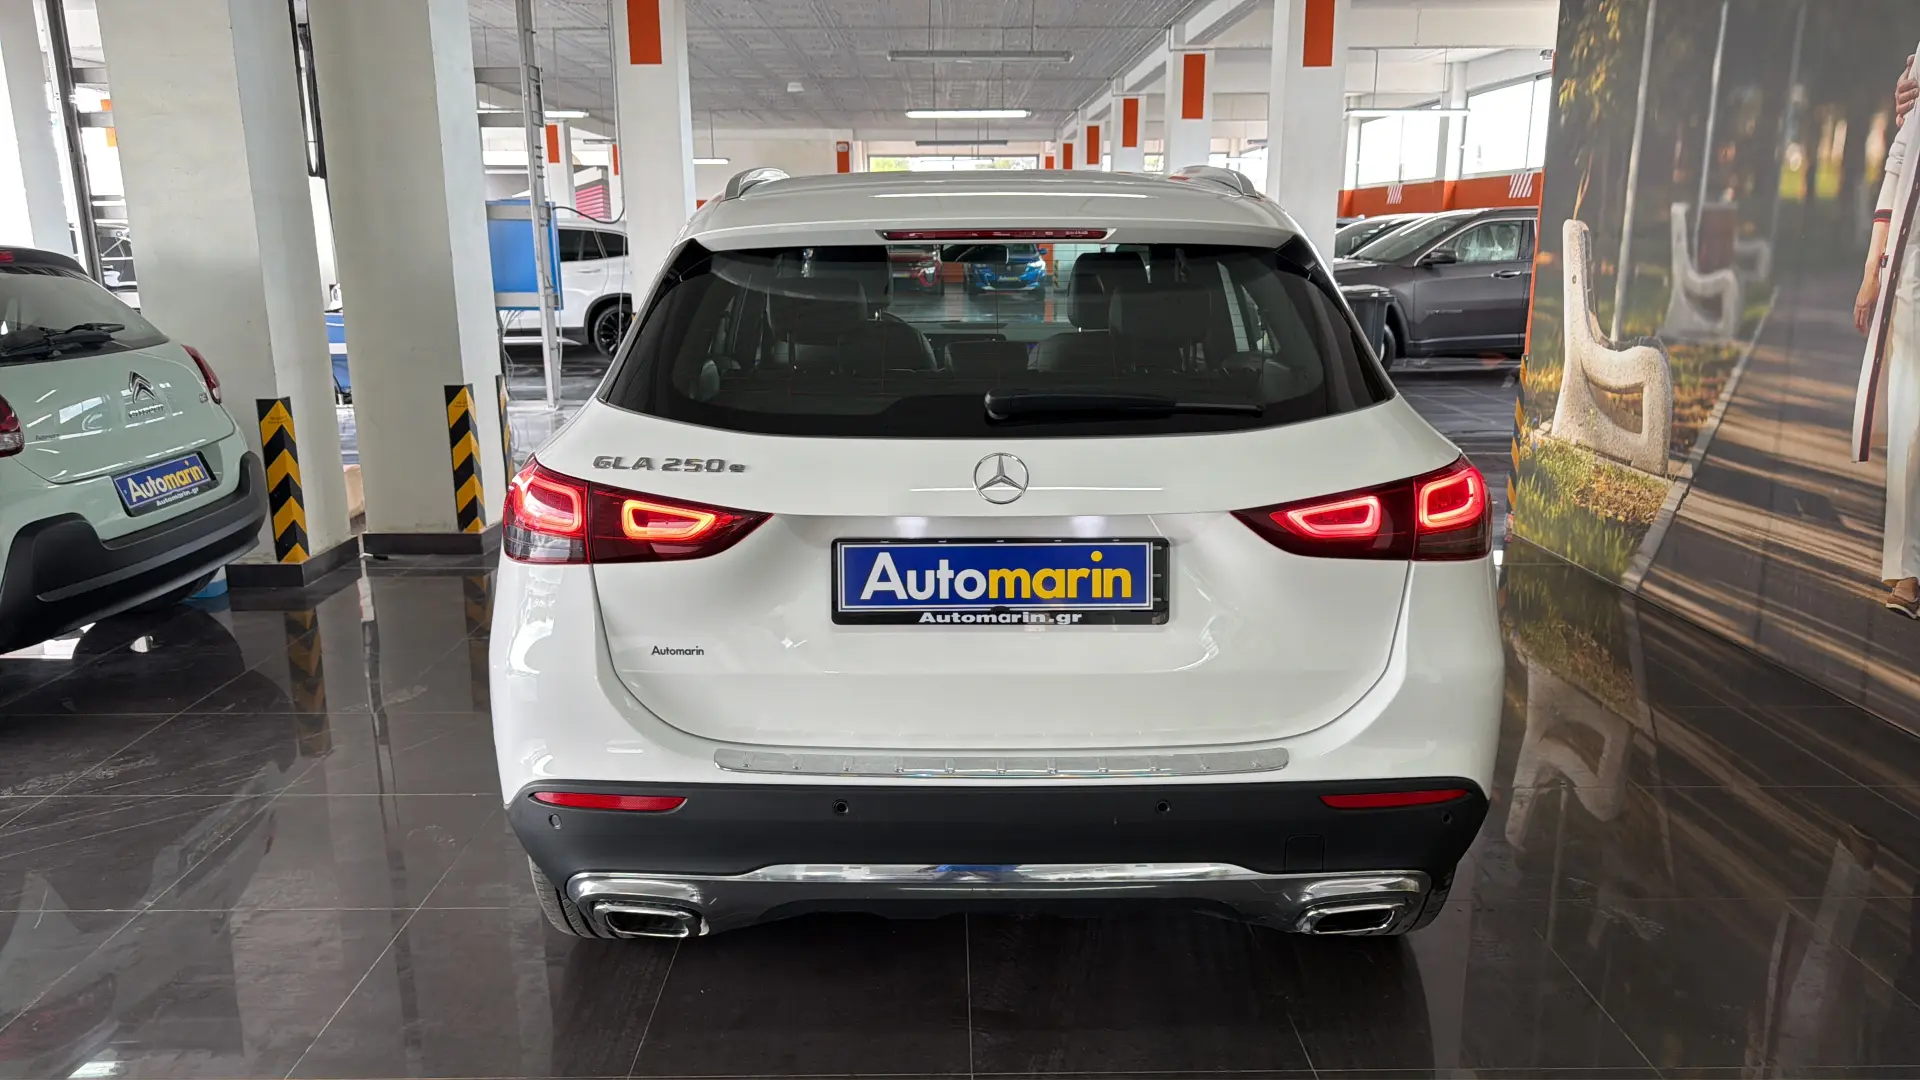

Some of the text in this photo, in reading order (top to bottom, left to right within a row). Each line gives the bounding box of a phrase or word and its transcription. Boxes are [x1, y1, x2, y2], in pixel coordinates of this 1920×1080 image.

[593, 455, 654, 471] GLA
[127, 460, 204, 503] Automarin
[156, 486, 199, 507] Automarin.gr
[860, 550, 1132, 600] Automarin
[919, 611, 1082, 625] Automarin.gr
[651, 645, 705, 656] Automarin
